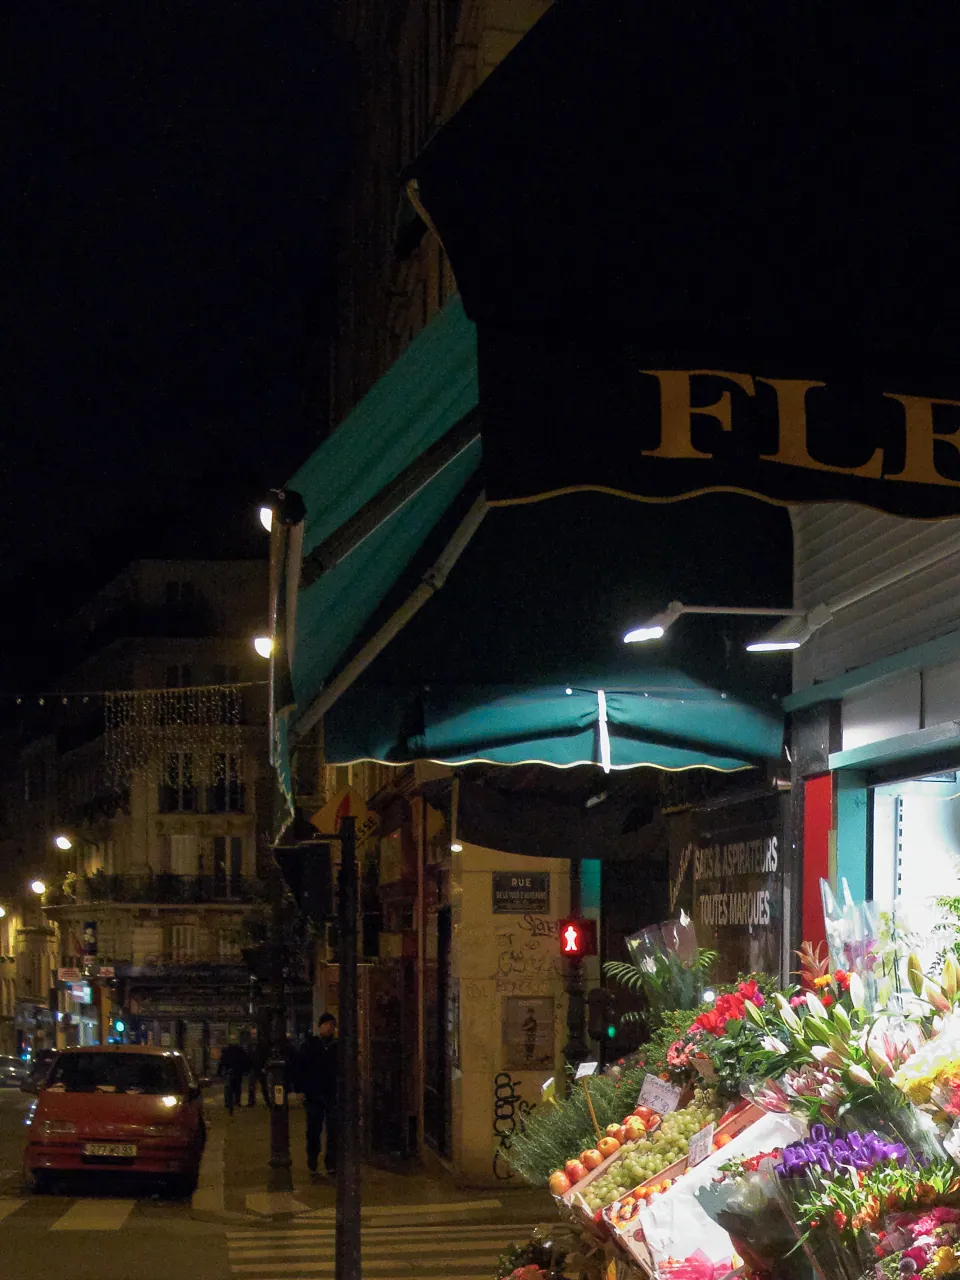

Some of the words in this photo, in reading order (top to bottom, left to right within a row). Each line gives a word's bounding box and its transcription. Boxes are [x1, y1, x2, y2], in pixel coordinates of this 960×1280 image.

[723, 836, 778, 876] ASPIRATEURS
[511, 878, 532, 887] RUE
[700, 893, 728, 926] TOUTES
[730, 890, 770, 925] MARQUES
